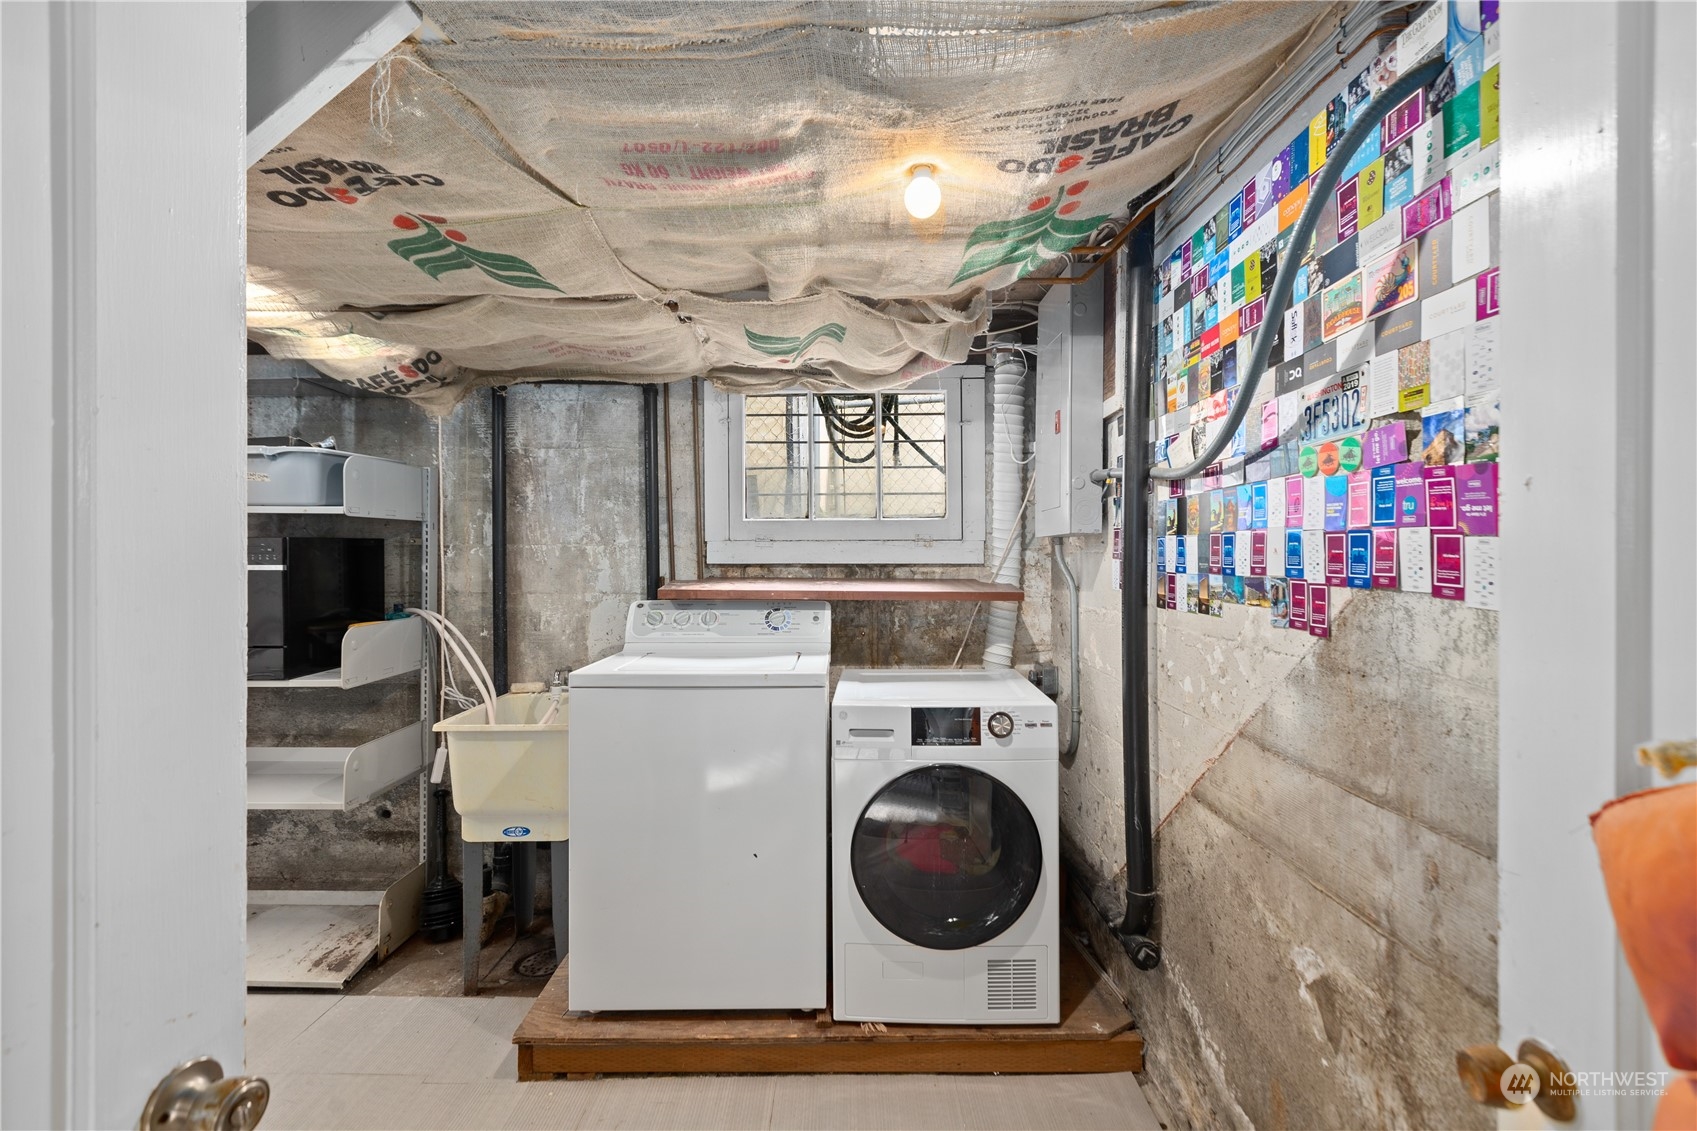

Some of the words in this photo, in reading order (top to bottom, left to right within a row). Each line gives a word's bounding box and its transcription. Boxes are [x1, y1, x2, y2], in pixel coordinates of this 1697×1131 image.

[1038, 100, 1181, 154] BRASIL
[259, 158, 394, 185] BRASIL
[619, 163, 645, 178] KG
[1398, 280, 1414, 301] 205
[1306, 381, 1344, 401] WASHINGTON
[1343, 379, 1359, 390] 2019
[1304, 389, 1360, 441] 3F5302
[1402, 500, 1415, 511] tru
